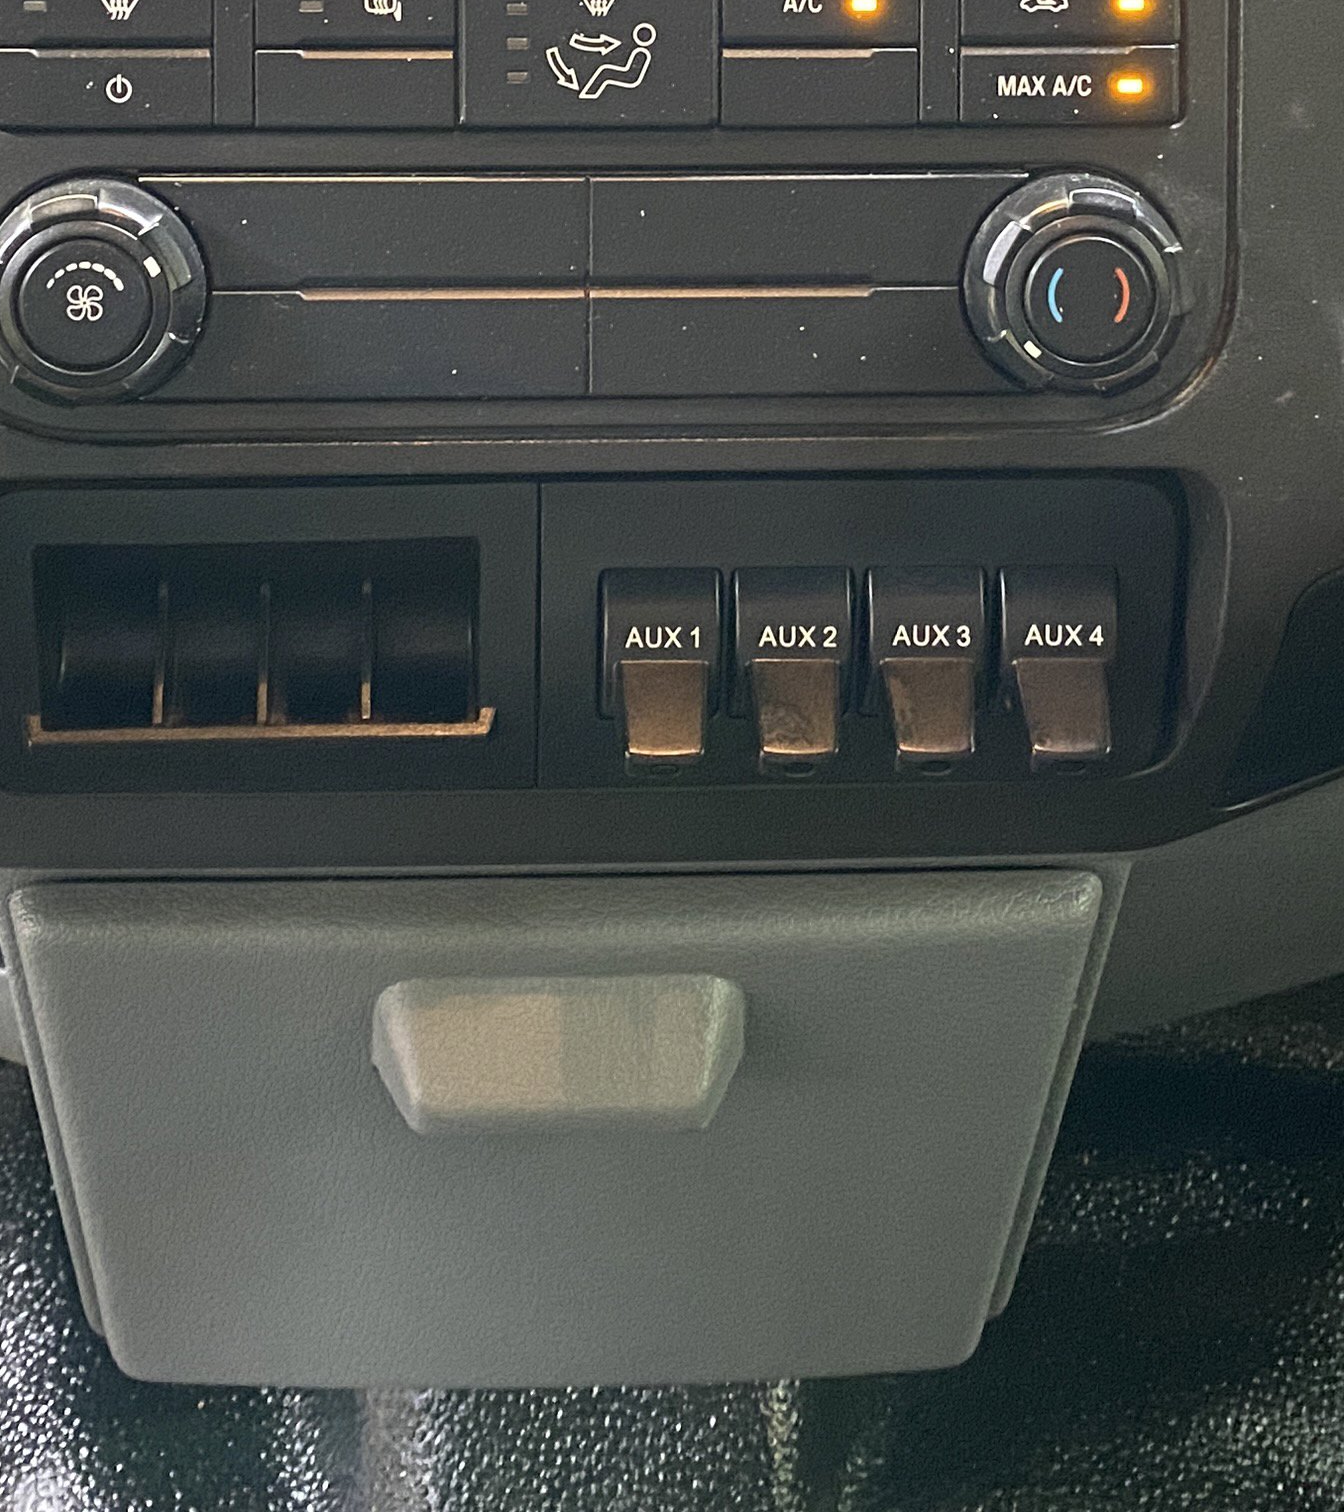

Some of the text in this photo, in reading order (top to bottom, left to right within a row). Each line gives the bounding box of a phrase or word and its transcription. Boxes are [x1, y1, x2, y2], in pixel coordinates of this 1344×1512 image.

[997, 74, 1092, 97] MAX A/C
[625, 626, 700, 649] AUX 1
[758, 625, 837, 648] AUX 2
[892, 624, 971, 648] AUX 3
[1024, 623, 1105, 647] AUX 4
